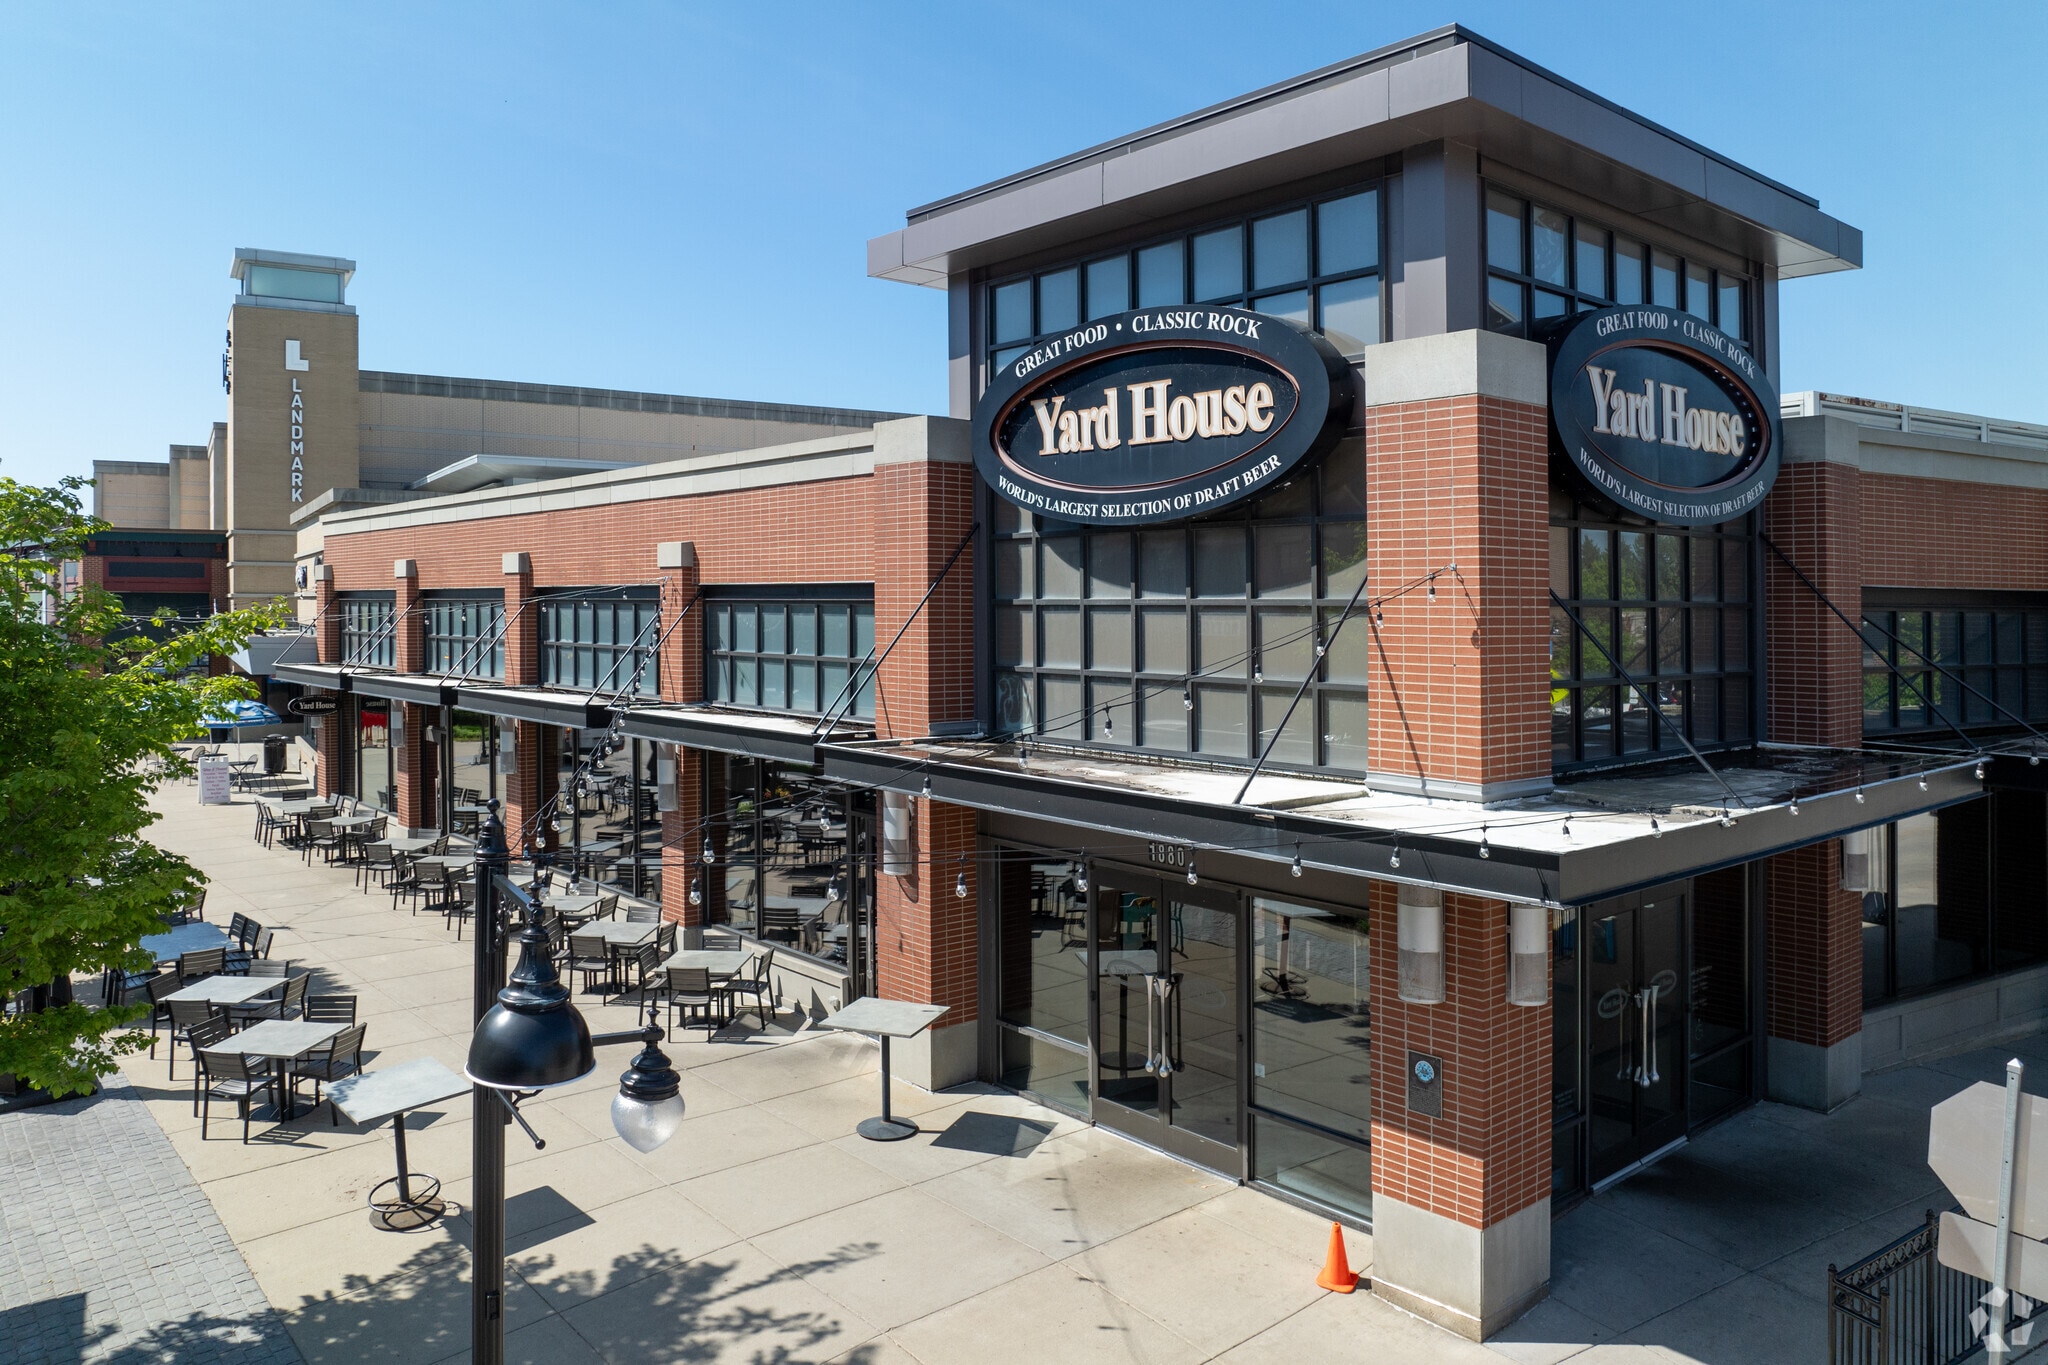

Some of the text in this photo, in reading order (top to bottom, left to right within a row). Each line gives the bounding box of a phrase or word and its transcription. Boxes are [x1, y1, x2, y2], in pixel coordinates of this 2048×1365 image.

[285, 340, 309, 371] L
[1015, 311, 1262, 378] GREAT FOOD CLASSIC ROCK
[1597, 311, 1757, 380] GREAT FOOD CLASSIC ROCK
[291, 378, 303, 502] LANDMARK
[1030, 379, 1275, 456] Yard House
[1586, 365, 1745, 457] Yard House
[999, 454, 1282, 517] WORLD'S LARGEST SELECTION OF DRAFT BEER
[1580, 447, 1765, 518] WORLD'S LARGEST SELECTION OF DRAFT BEER
[299, 701, 336, 710] Yard House
